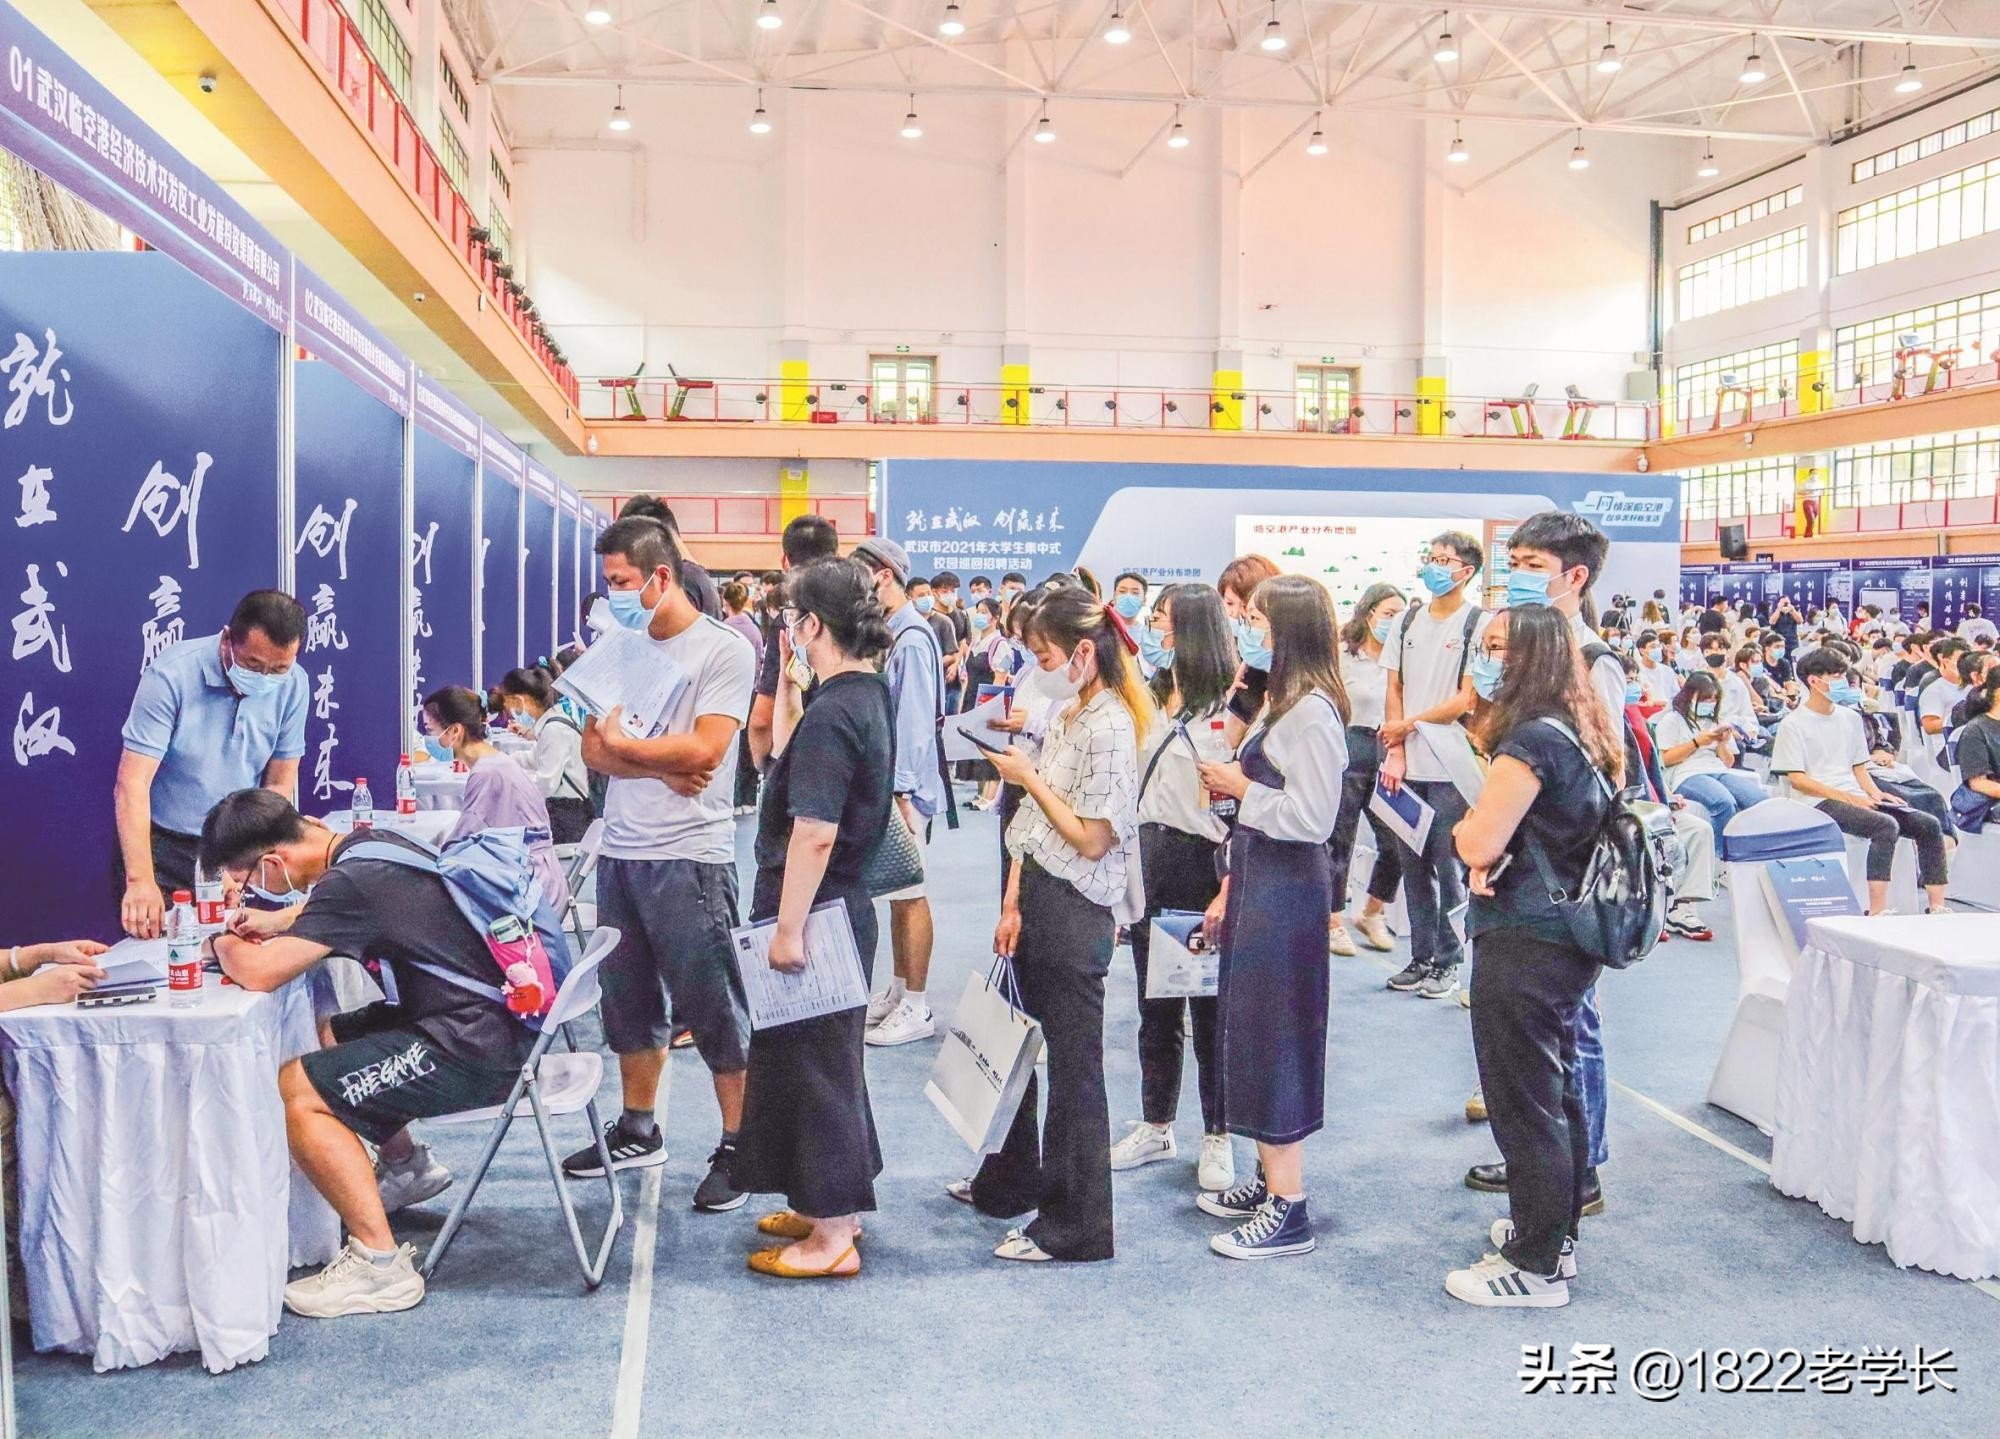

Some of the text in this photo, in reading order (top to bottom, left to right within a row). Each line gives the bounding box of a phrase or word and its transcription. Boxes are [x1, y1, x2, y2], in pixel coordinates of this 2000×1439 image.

[903, 540, 1062, 556] 武汉市2021年大学生集中式
[933, 556, 1033, 571] 校园巡回招聘活动
